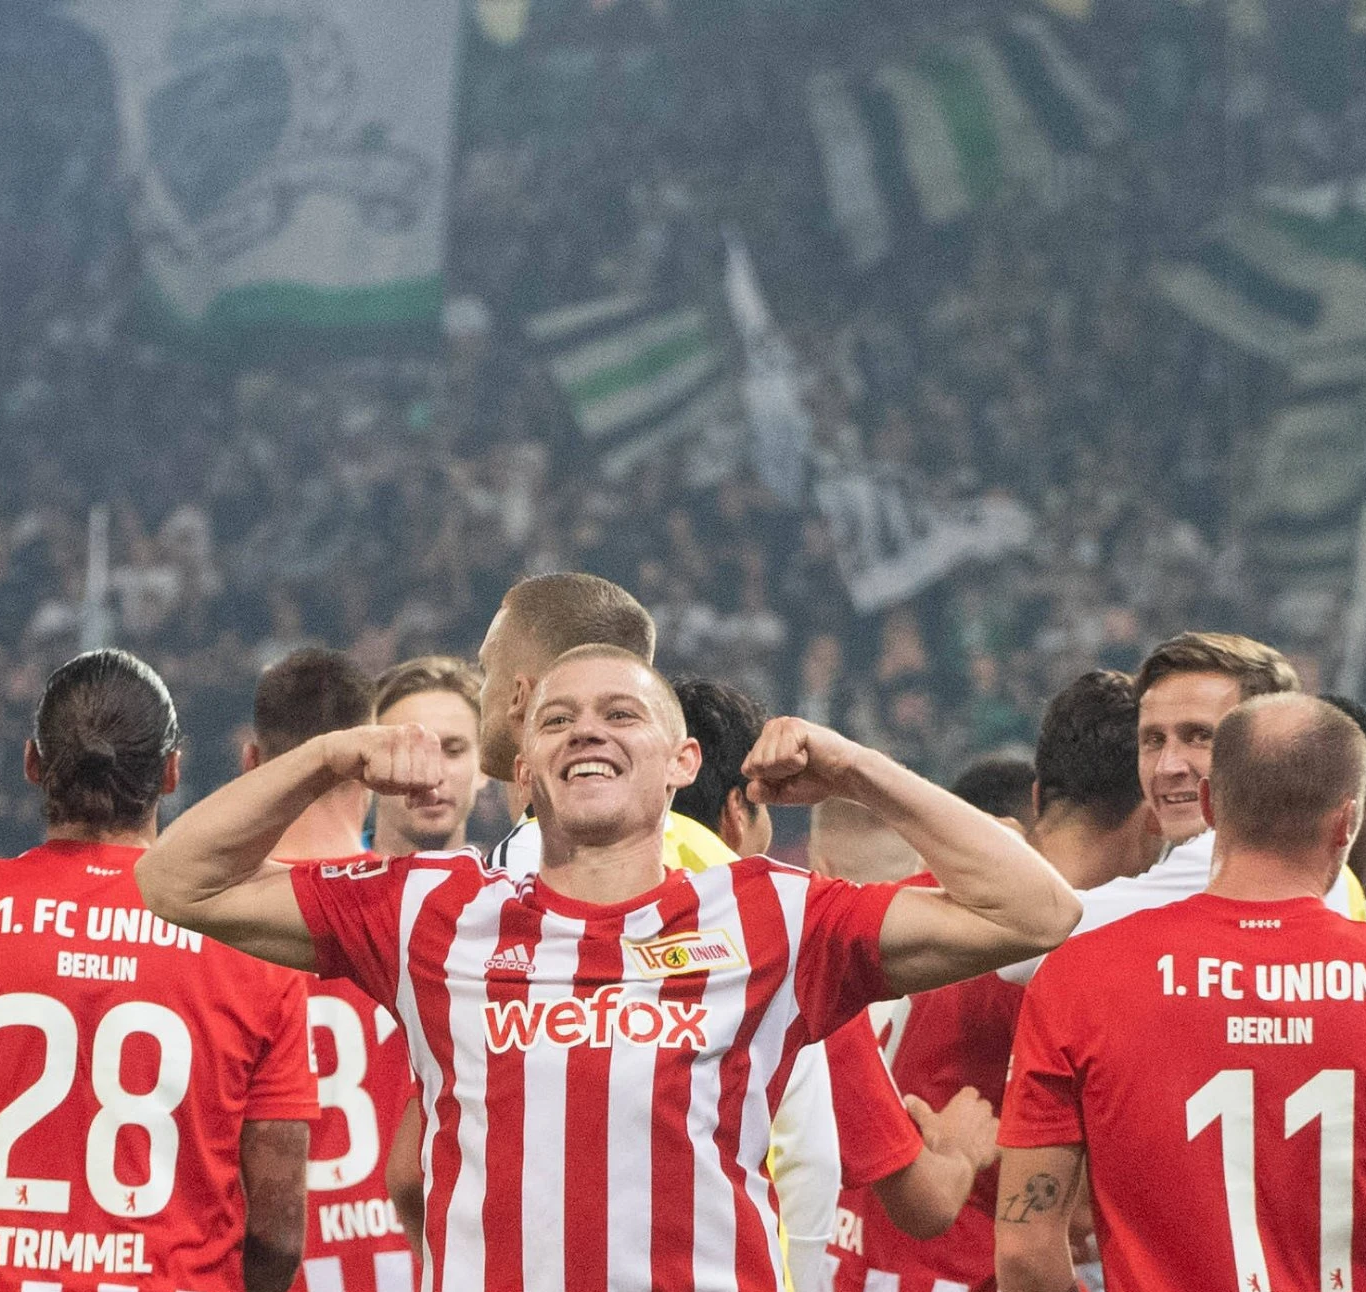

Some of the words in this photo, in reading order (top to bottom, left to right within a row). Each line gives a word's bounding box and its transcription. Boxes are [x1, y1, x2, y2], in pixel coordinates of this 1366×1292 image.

[33, 898, 78, 938] FC
[57, 950, 138, 982] BERLIN
[484, 959, 536, 975] adidas
[688, 944, 731, 962] UNION
[1157, 954, 1187, 996] 1.
[1198, 957, 1244, 1000] FC
[482, 984, 712, 1054] wefox
[1227, 1016, 1313, 1044] BERLIN
